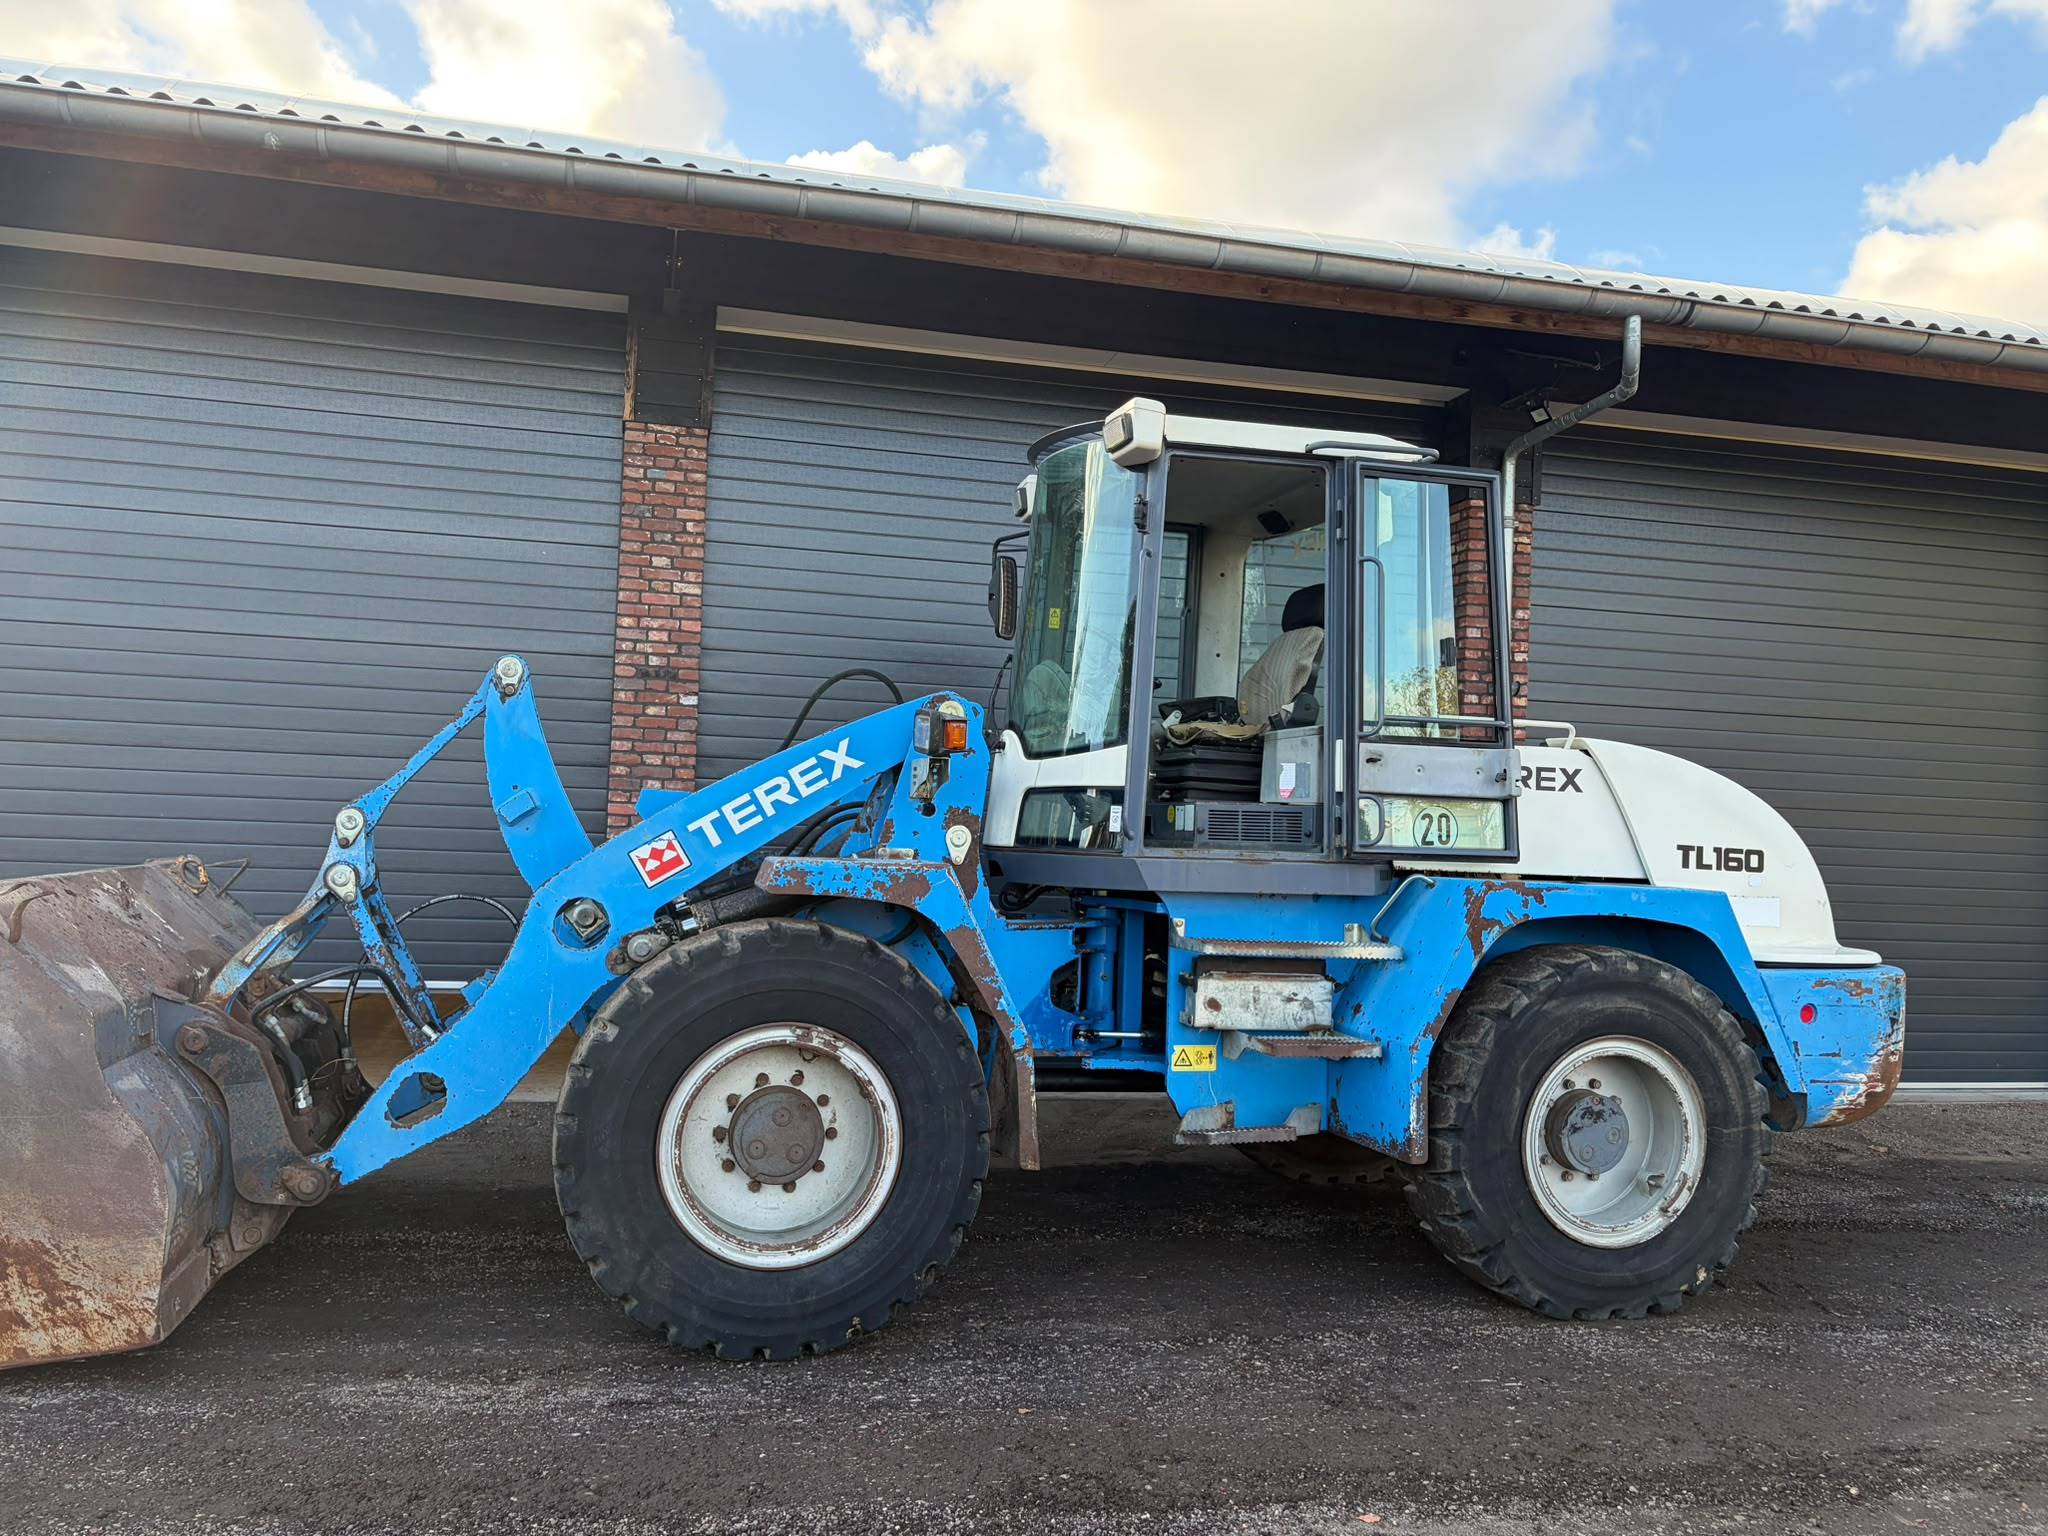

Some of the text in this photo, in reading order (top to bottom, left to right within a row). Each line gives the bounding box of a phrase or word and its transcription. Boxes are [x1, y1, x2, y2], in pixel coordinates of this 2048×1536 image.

[687, 737, 866, 848] TEREX
[1520, 765, 1584, 793] REX
[1421, 813, 1451, 846] 20
[1677, 844, 1764, 873] TL160
